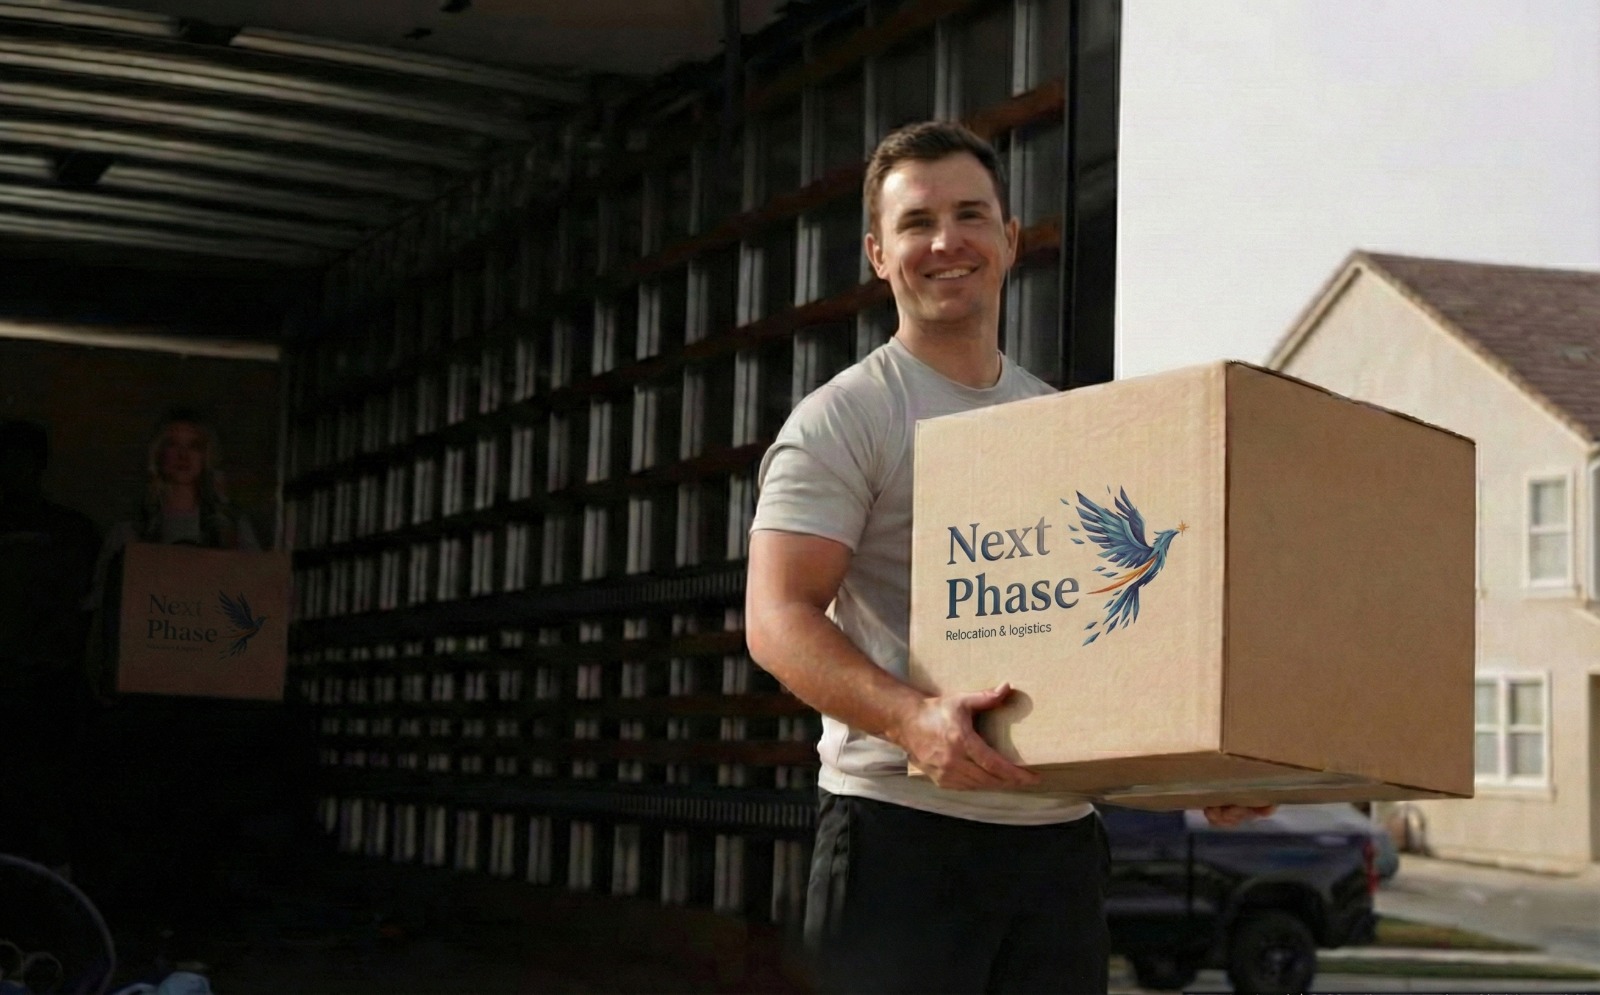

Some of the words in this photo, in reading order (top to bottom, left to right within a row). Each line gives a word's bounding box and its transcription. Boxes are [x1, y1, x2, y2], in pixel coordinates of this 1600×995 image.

[947, 517, 1052, 565] Next
[149, 594, 203, 616] Next
[946, 573, 1079, 619] Phase
[147, 620, 218, 643] Phase
[946, 627, 997, 640] Relocation
[1000, 626, 1007, 636] &
[1009, 623, 1052, 638] logistics
